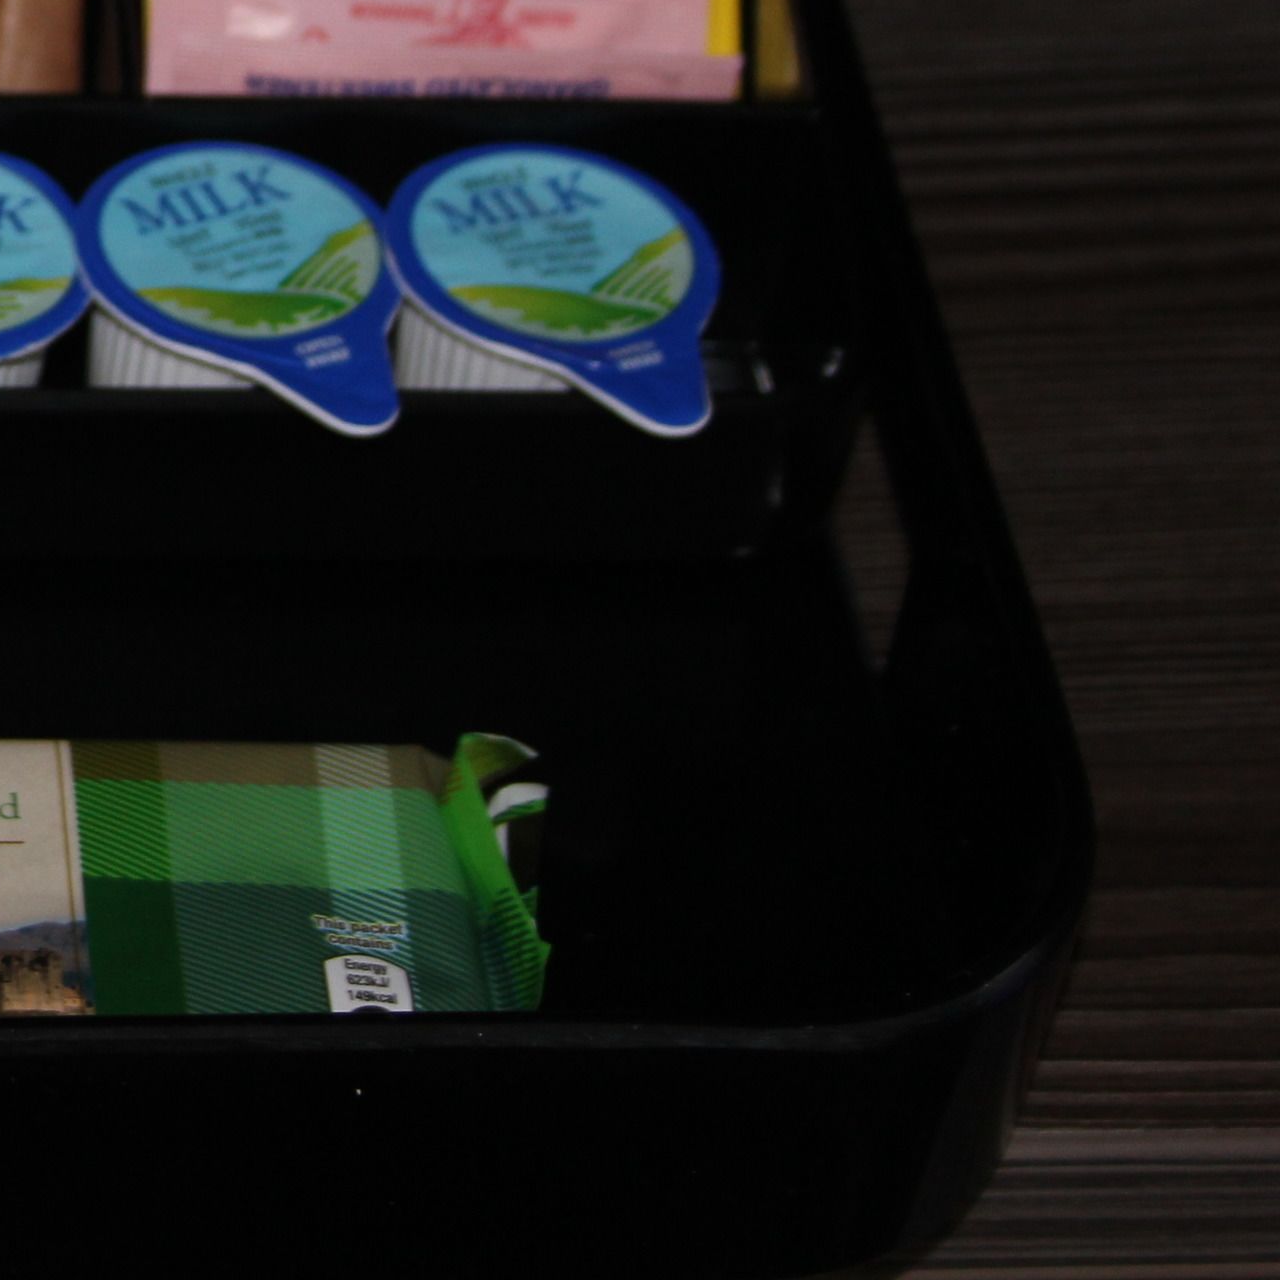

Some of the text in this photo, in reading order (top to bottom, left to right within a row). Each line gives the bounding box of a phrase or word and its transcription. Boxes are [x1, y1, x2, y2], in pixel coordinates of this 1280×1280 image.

[119, 166, 293, 236] MILK
[431, 171, 607, 235] MILK
[313, 914, 347, 931] This
[344, 958, 388, 976] Energy
